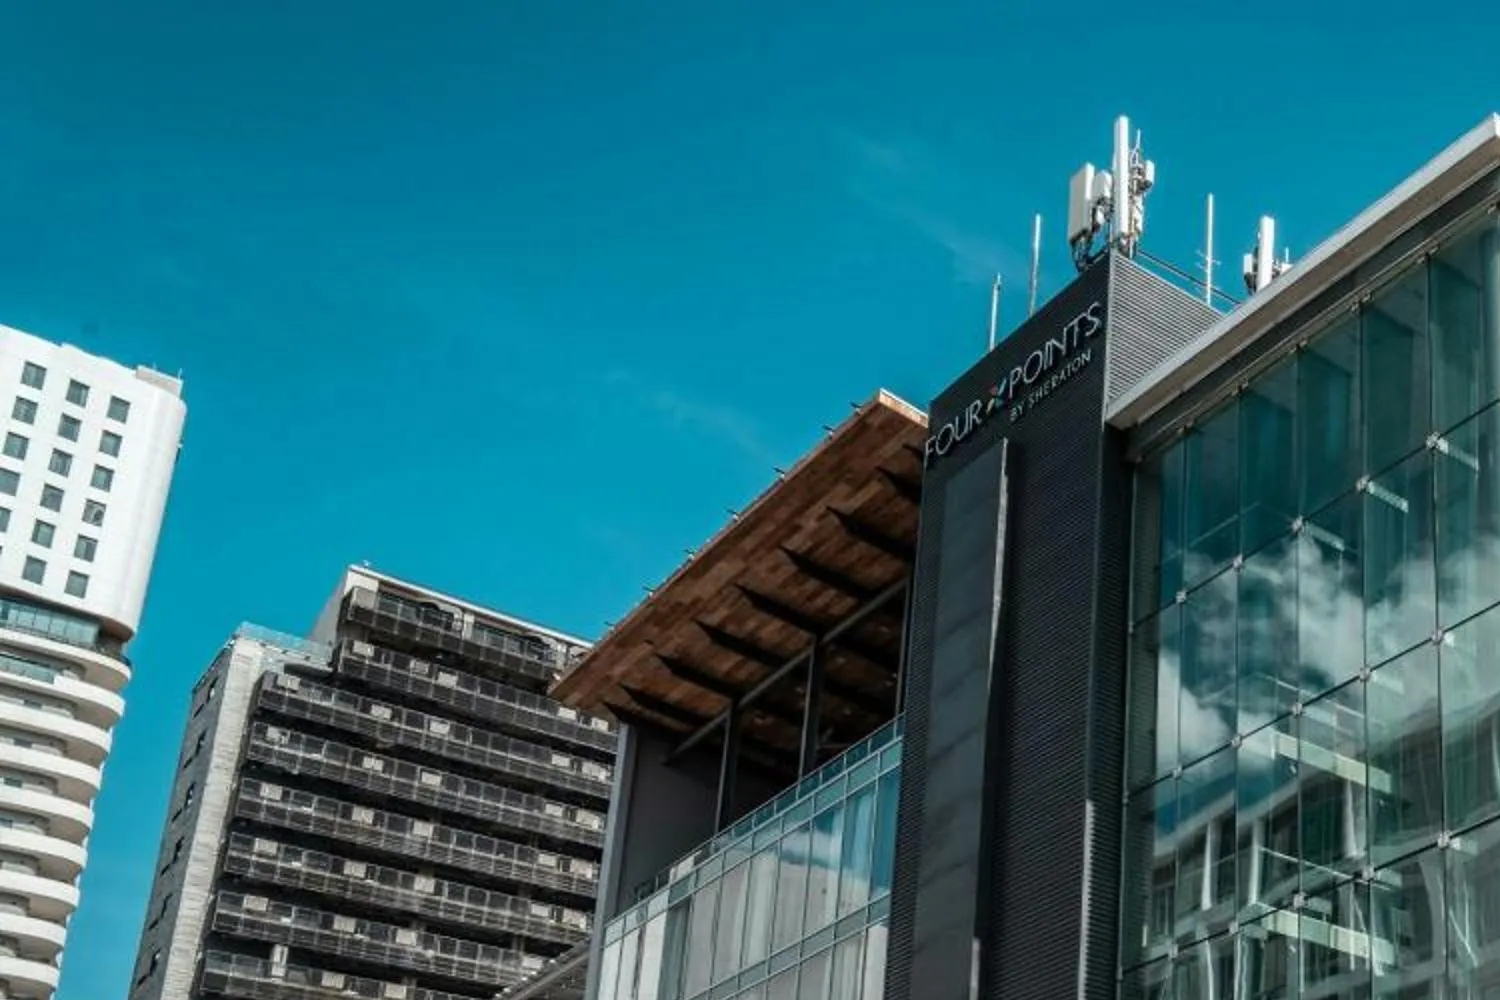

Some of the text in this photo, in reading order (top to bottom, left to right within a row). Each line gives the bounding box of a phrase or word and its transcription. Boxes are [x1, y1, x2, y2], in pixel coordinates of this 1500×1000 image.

[926, 301, 1102, 455] FOUR POINTS
[1028, 348, 1092, 409] SHERATON
